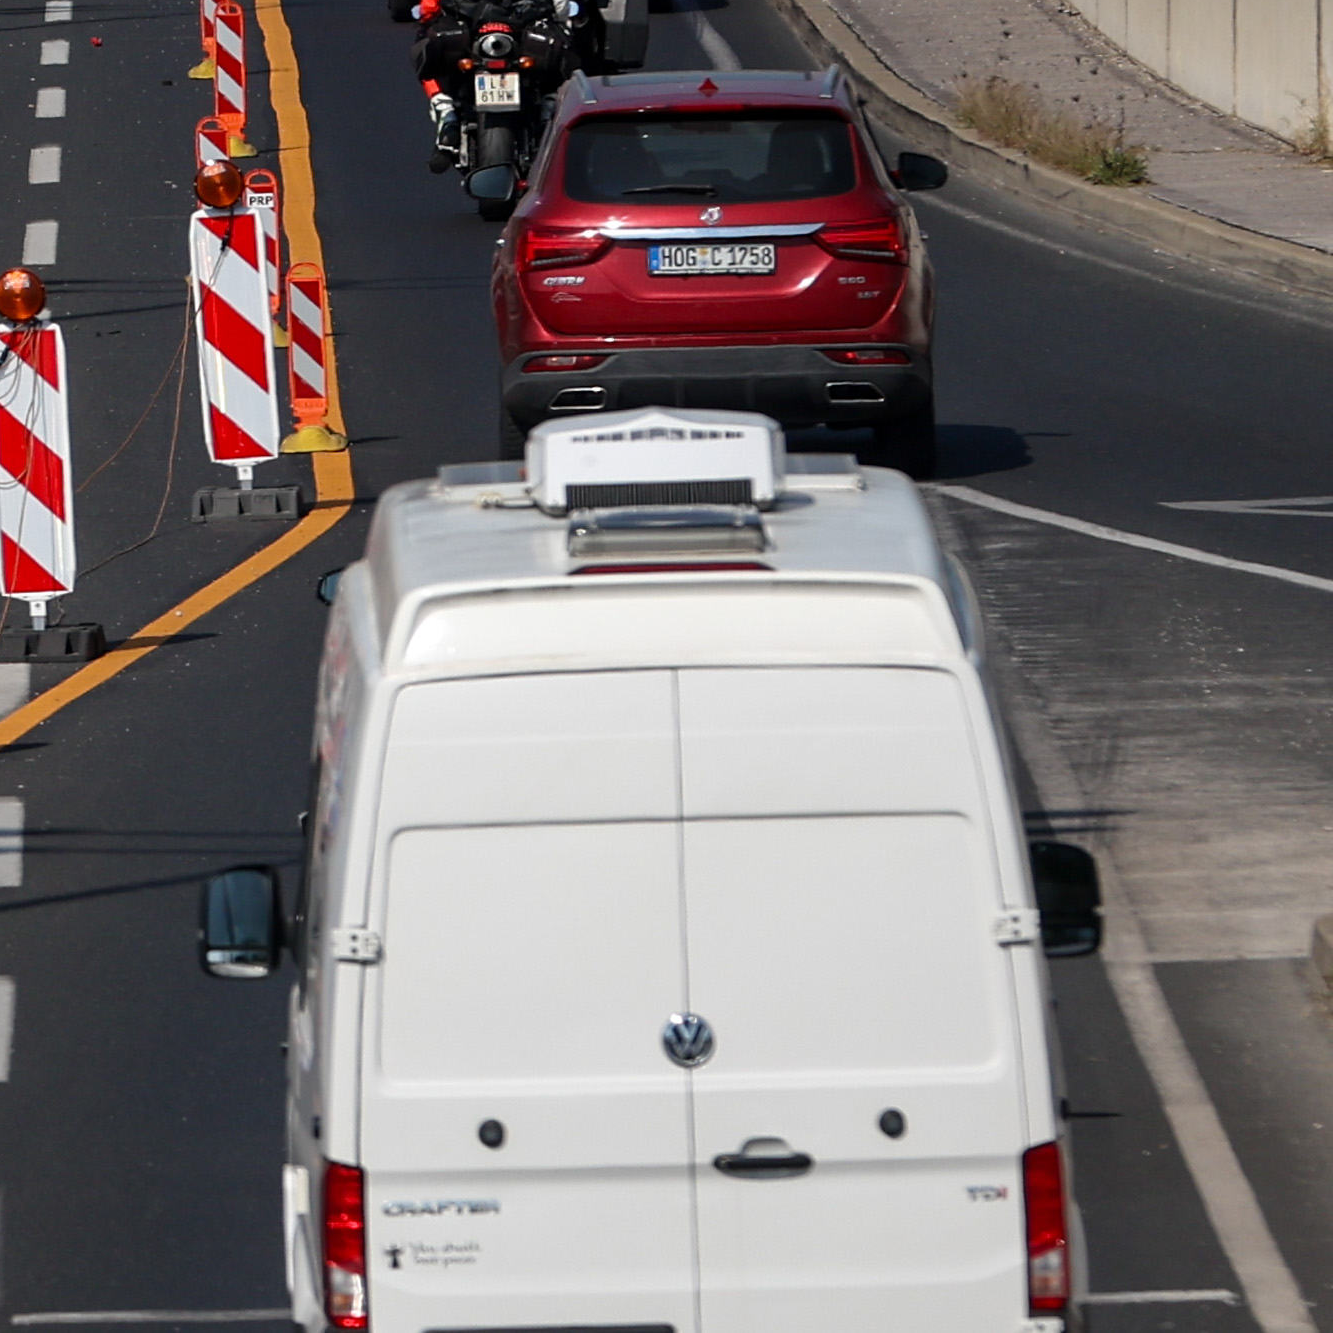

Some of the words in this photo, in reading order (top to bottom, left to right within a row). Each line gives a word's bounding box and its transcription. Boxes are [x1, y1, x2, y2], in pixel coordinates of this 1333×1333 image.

[490, 78, 496, 89] L
[481, 91, 495, 103] 61
[249, 196, 273, 206] PRP
[662, 247, 698, 267] HOG
[712, 247, 722, 266] C
[727, 246, 773, 266] 1758
[382, 1199, 500, 1215] CRAFTER
